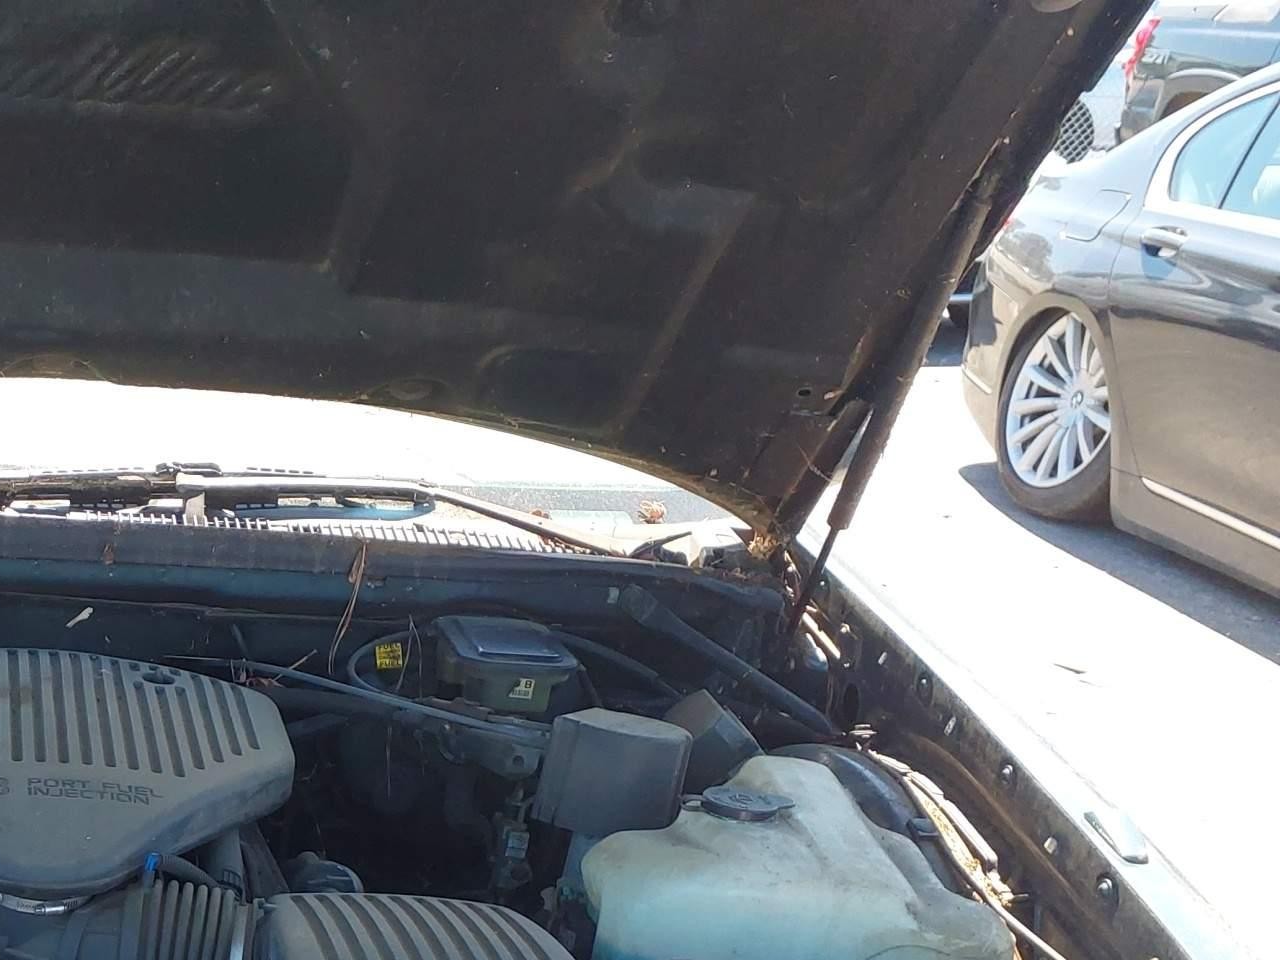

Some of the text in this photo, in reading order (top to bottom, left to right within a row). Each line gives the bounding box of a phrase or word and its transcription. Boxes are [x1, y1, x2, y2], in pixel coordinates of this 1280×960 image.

[27, 777, 164, 798] PORT FUEL
[27, 786, 150, 805] INJECTION
